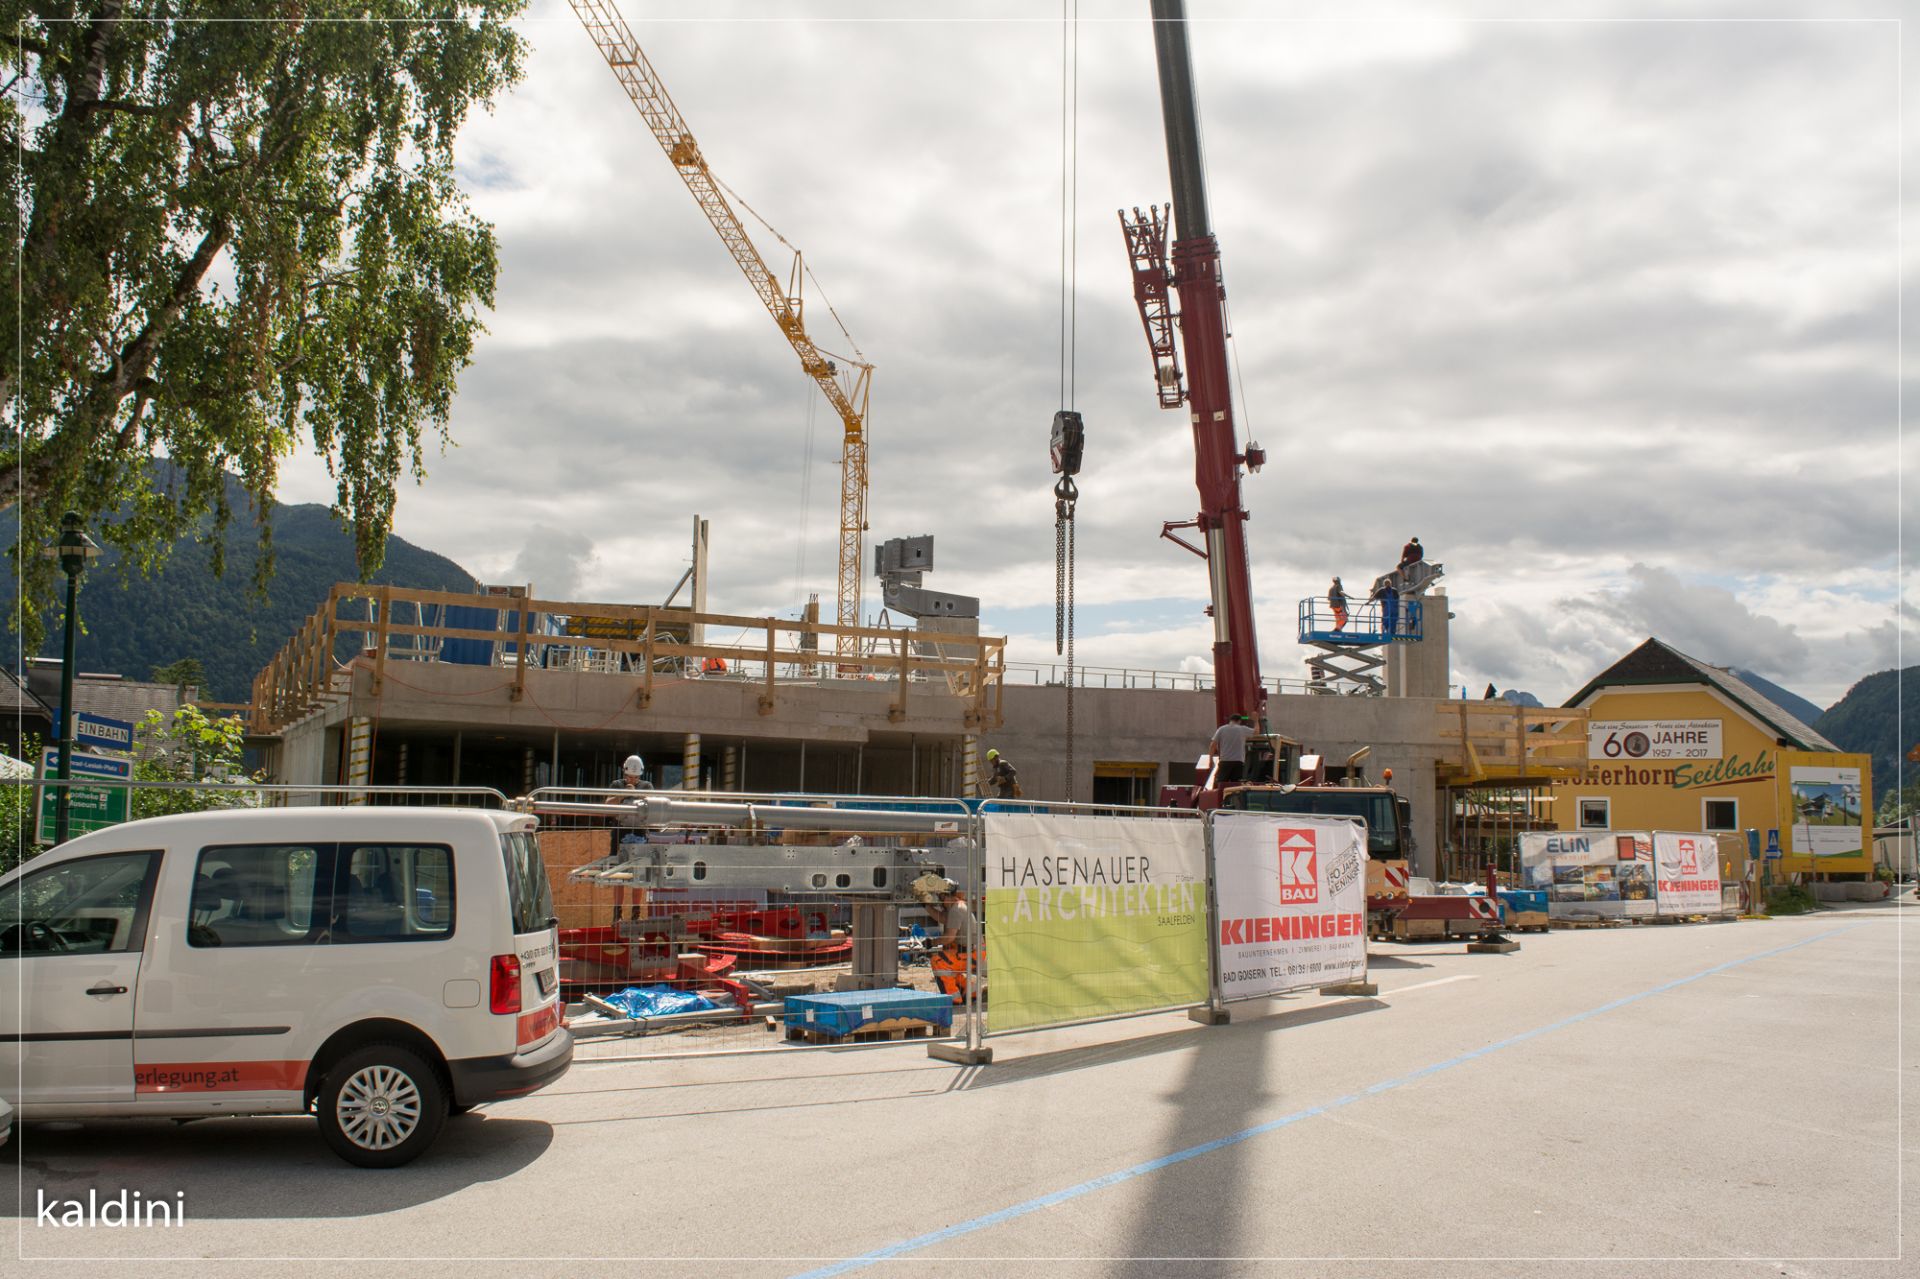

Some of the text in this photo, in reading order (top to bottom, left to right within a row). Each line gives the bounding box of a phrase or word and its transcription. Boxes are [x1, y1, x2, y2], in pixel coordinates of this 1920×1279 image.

[79, 722, 129, 742] EINBAHN
[1603, 731, 1708, 758] 60 JAHRE
[1652, 749, 1672, 757] 1957
[1686, 749, 1708, 757] 2017
[1001, 856, 1151, 887] HASENAUER
[1282, 888, 1317, 901] BAU
[1157, 914, 1196, 927] SAALFELDEN
[1221, 913, 1363, 946] KIENINGER
[1238, 947, 1289, 959] BAUUNTERNEHMEN
[1223, 971, 1236, 983] BAD
[1238, 968, 1267, 982] GOISERN
[135, 1068, 240, 1088] erlegung.at
